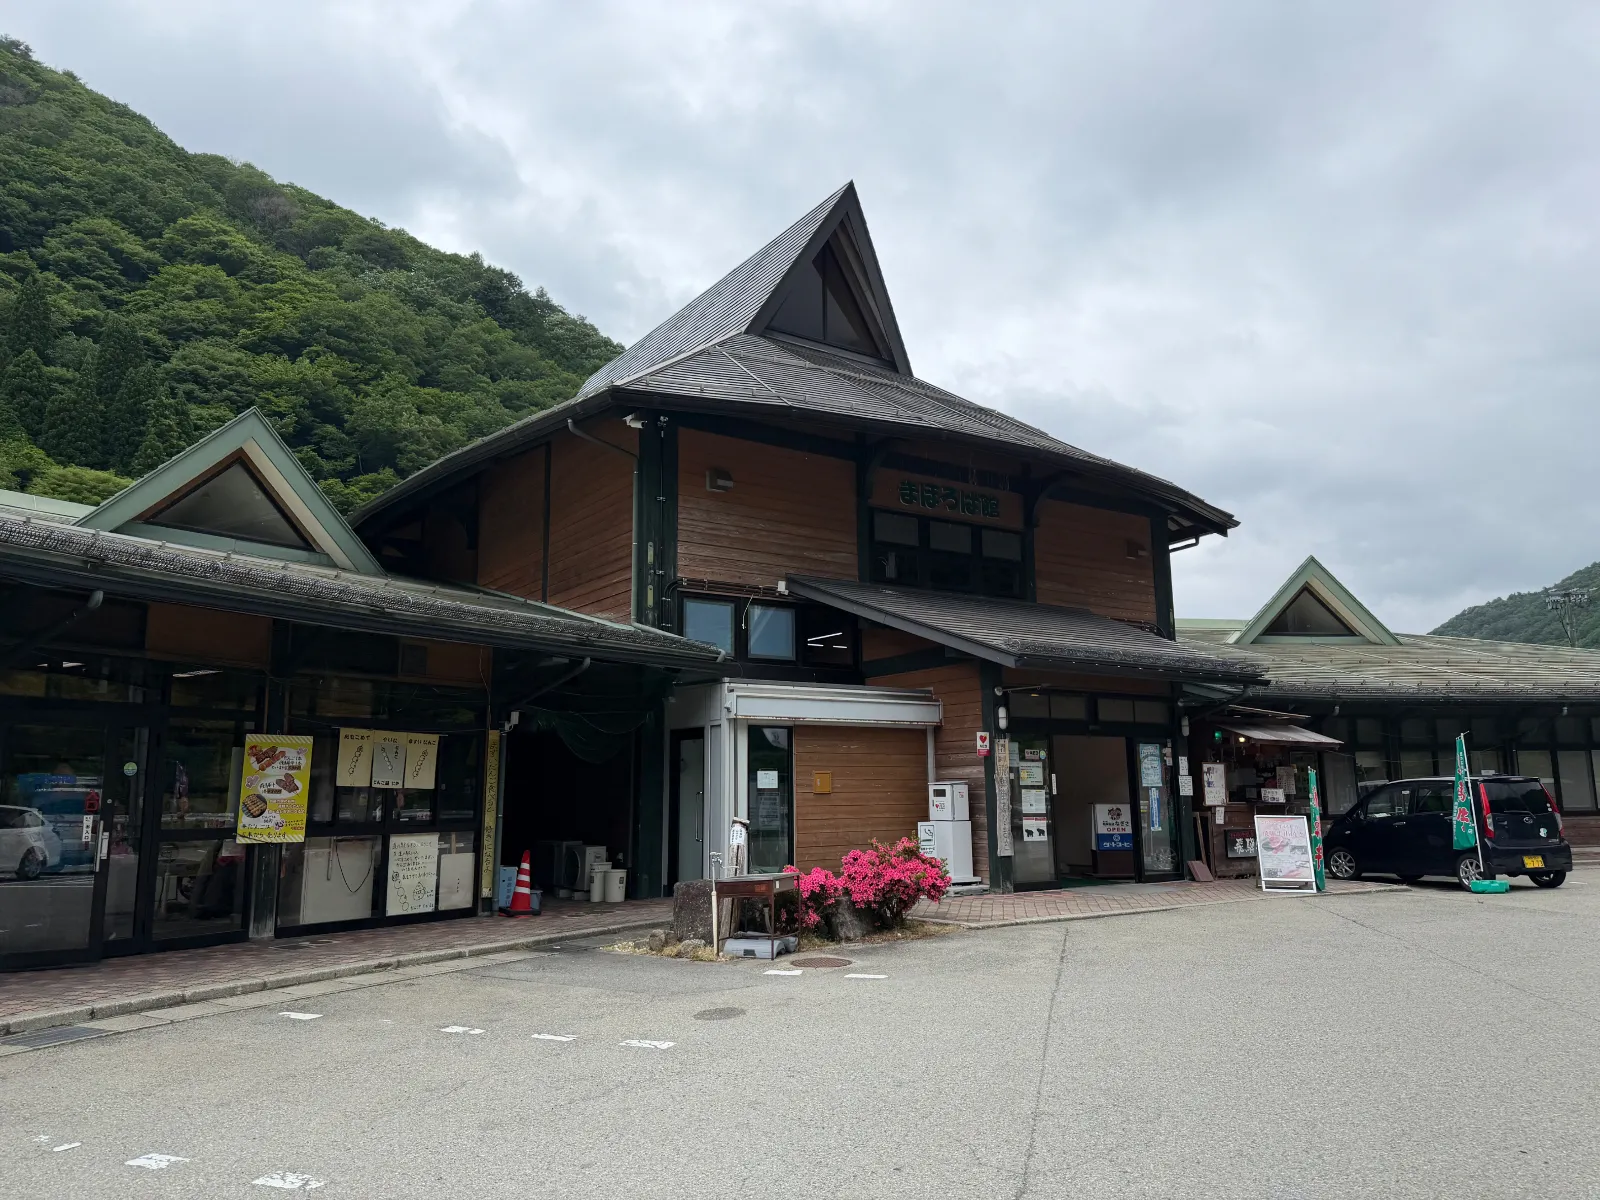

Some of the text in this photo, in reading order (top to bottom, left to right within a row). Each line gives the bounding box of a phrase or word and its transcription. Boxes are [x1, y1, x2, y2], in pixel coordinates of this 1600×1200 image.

[898, 480, 1000, 519] まほろば館
